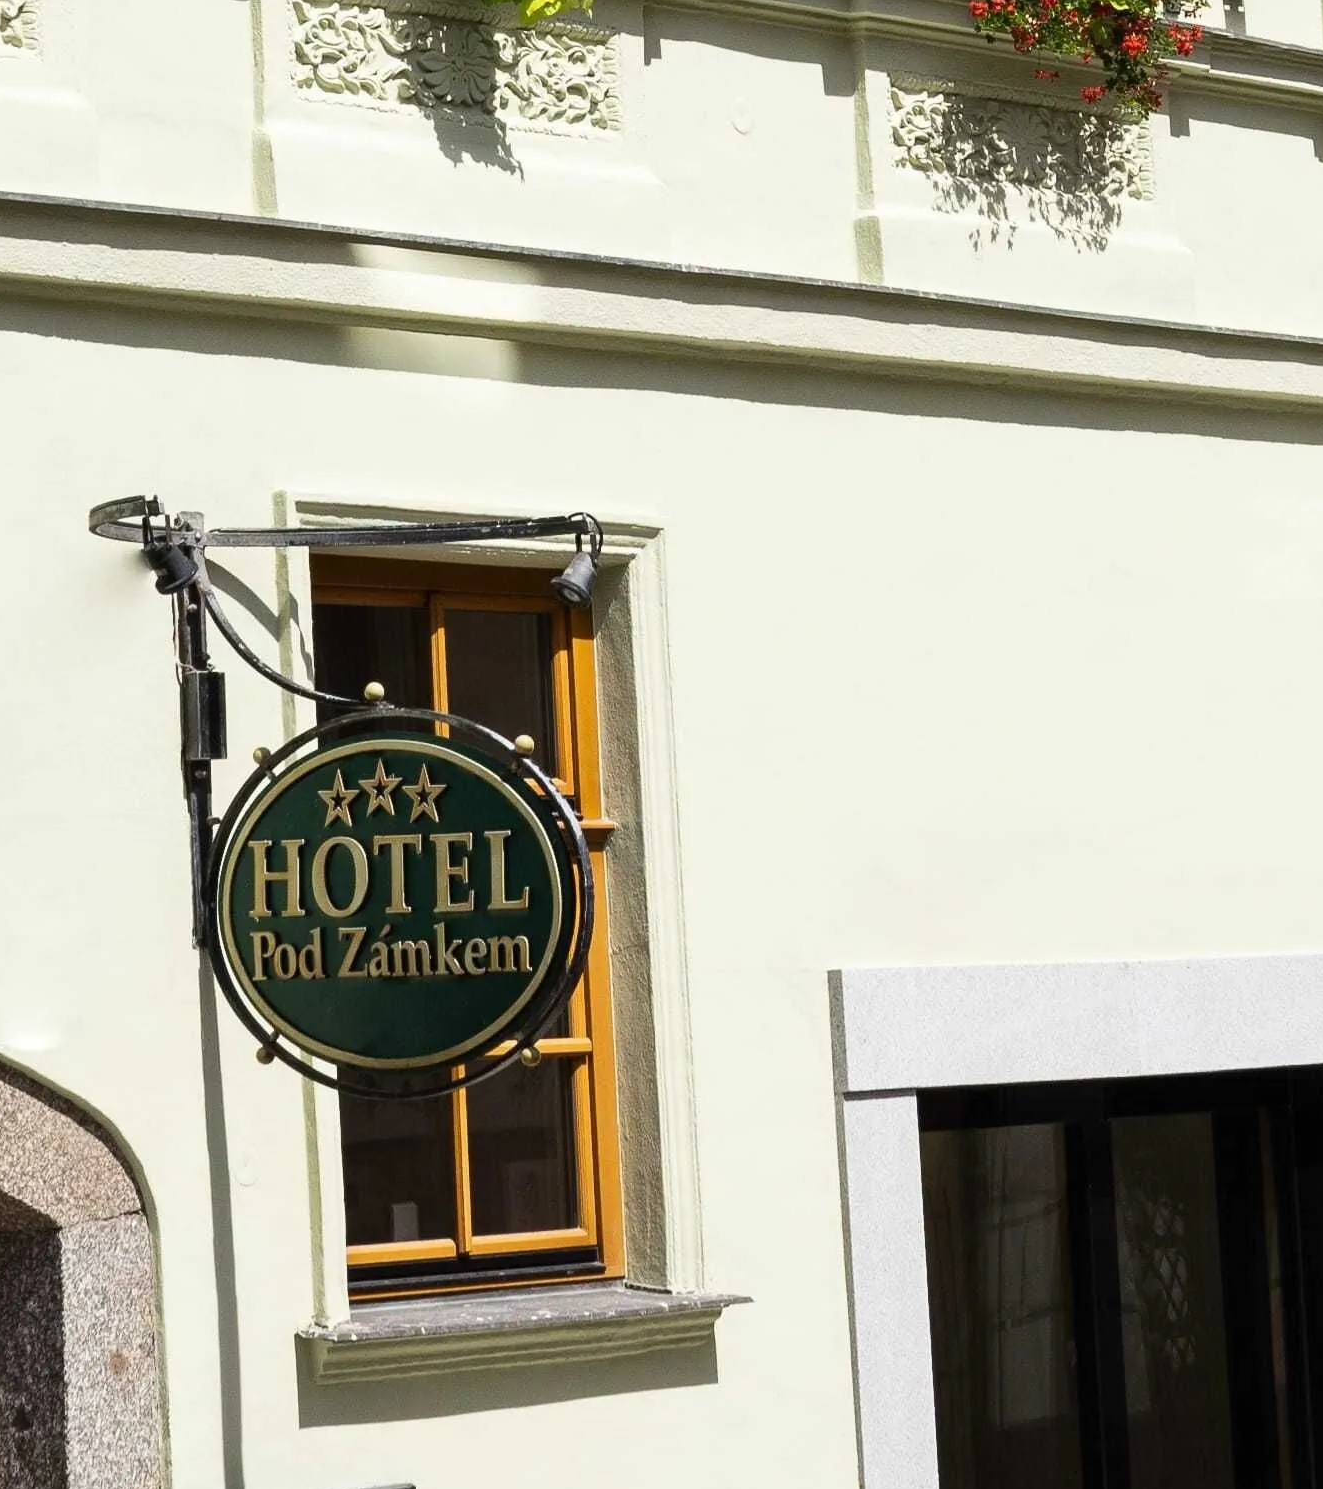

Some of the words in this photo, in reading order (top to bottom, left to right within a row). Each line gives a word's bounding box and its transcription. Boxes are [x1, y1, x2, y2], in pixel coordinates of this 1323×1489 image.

[248, 830, 529, 917] HOTEL
[251, 929, 326, 982] Pod
[337, 923, 532, 979] Zámkem
